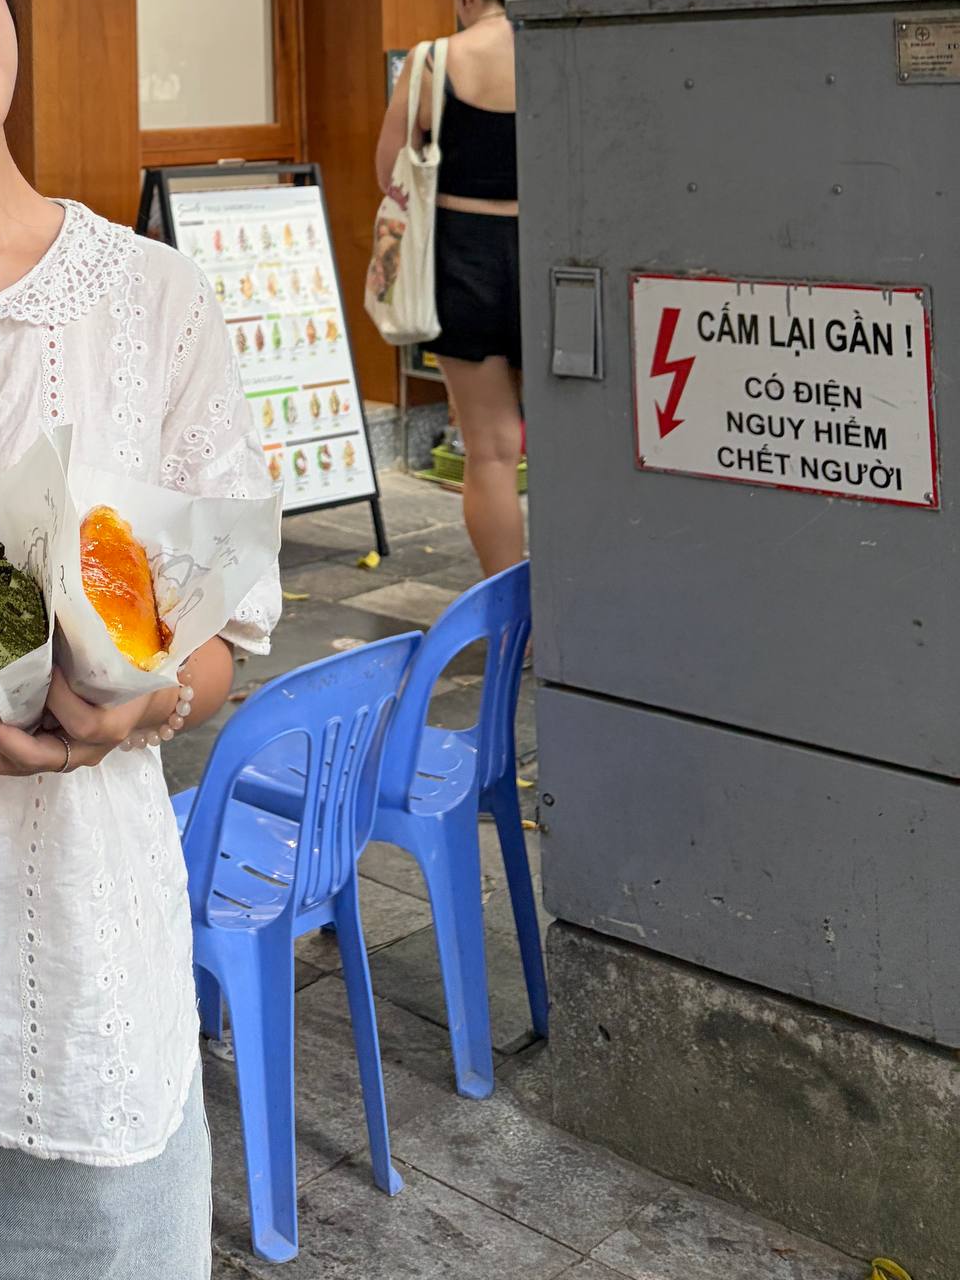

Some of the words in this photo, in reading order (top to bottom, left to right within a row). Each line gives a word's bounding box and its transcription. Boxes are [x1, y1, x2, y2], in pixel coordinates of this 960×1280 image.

[697, 301, 759, 345] CẤM
[769, 315, 815, 358] LẠI
[744, 373, 785, 400] CÓ
[793, 379, 862, 412] ĐIỆN
[726, 411, 805, 441] NGUY
[814, 414, 887, 451] HIỂM
[717, 444, 790, 476] CHẾT
[800, 455, 903, 491] NGƯỜI
